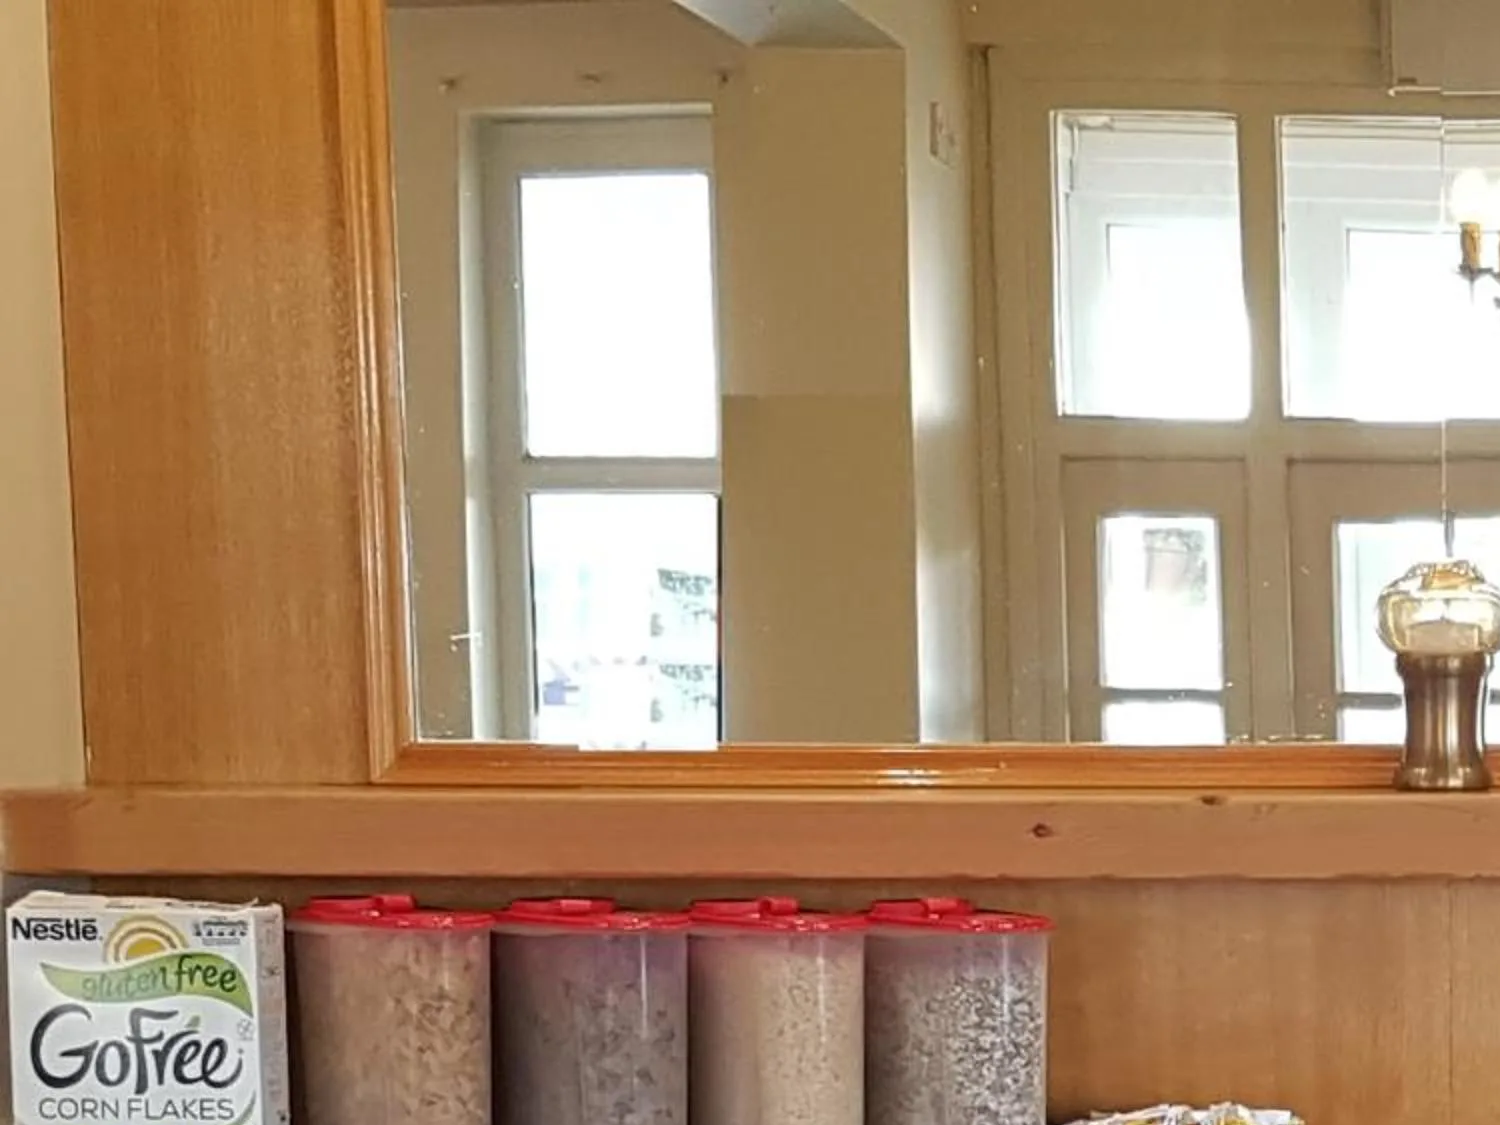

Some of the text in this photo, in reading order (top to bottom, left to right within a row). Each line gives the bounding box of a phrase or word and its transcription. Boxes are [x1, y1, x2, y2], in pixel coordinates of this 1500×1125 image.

[12, 917, 98, 941] Nestlé
[174, 955, 237, 992] free
[38, 1097, 235, 1121] CORN FLAKES
